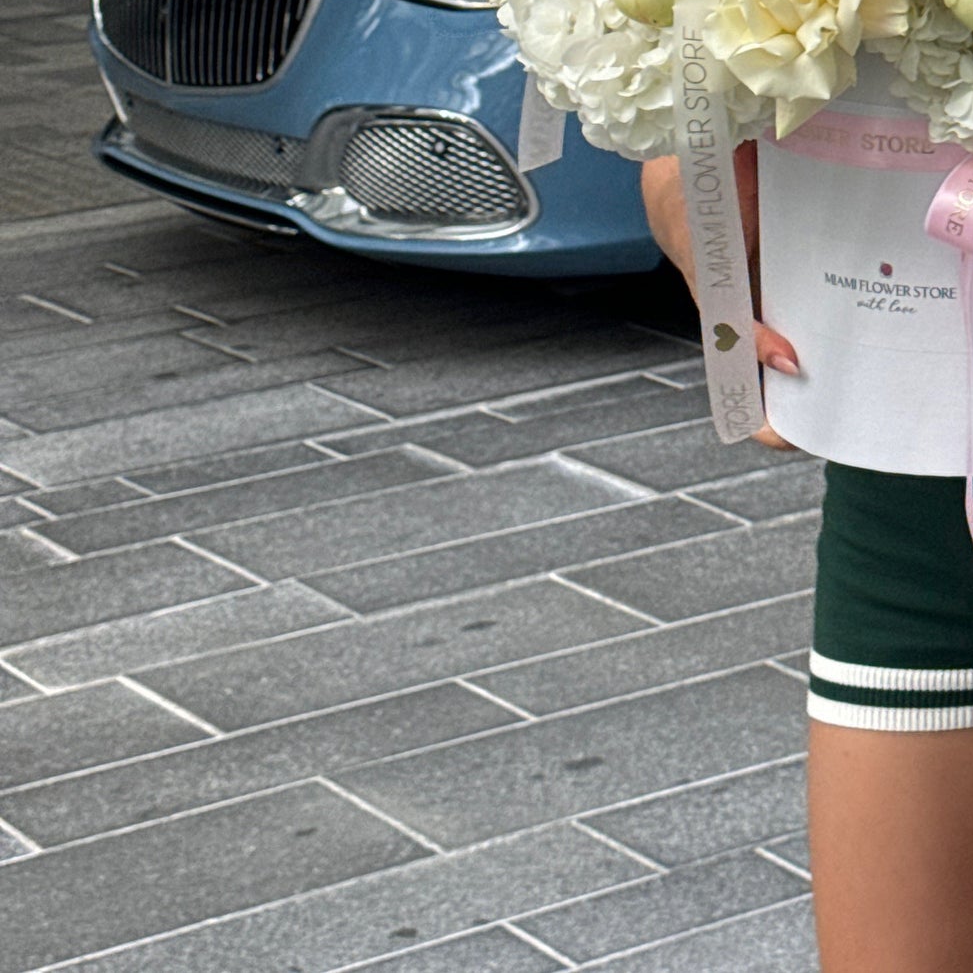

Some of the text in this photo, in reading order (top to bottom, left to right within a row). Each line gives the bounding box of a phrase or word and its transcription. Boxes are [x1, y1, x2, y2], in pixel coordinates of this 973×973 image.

[682, 26, 734, 289] MIAMI FLOWER STORE
[824, 272, 957, 299] MIAMI FLOWER STORE
